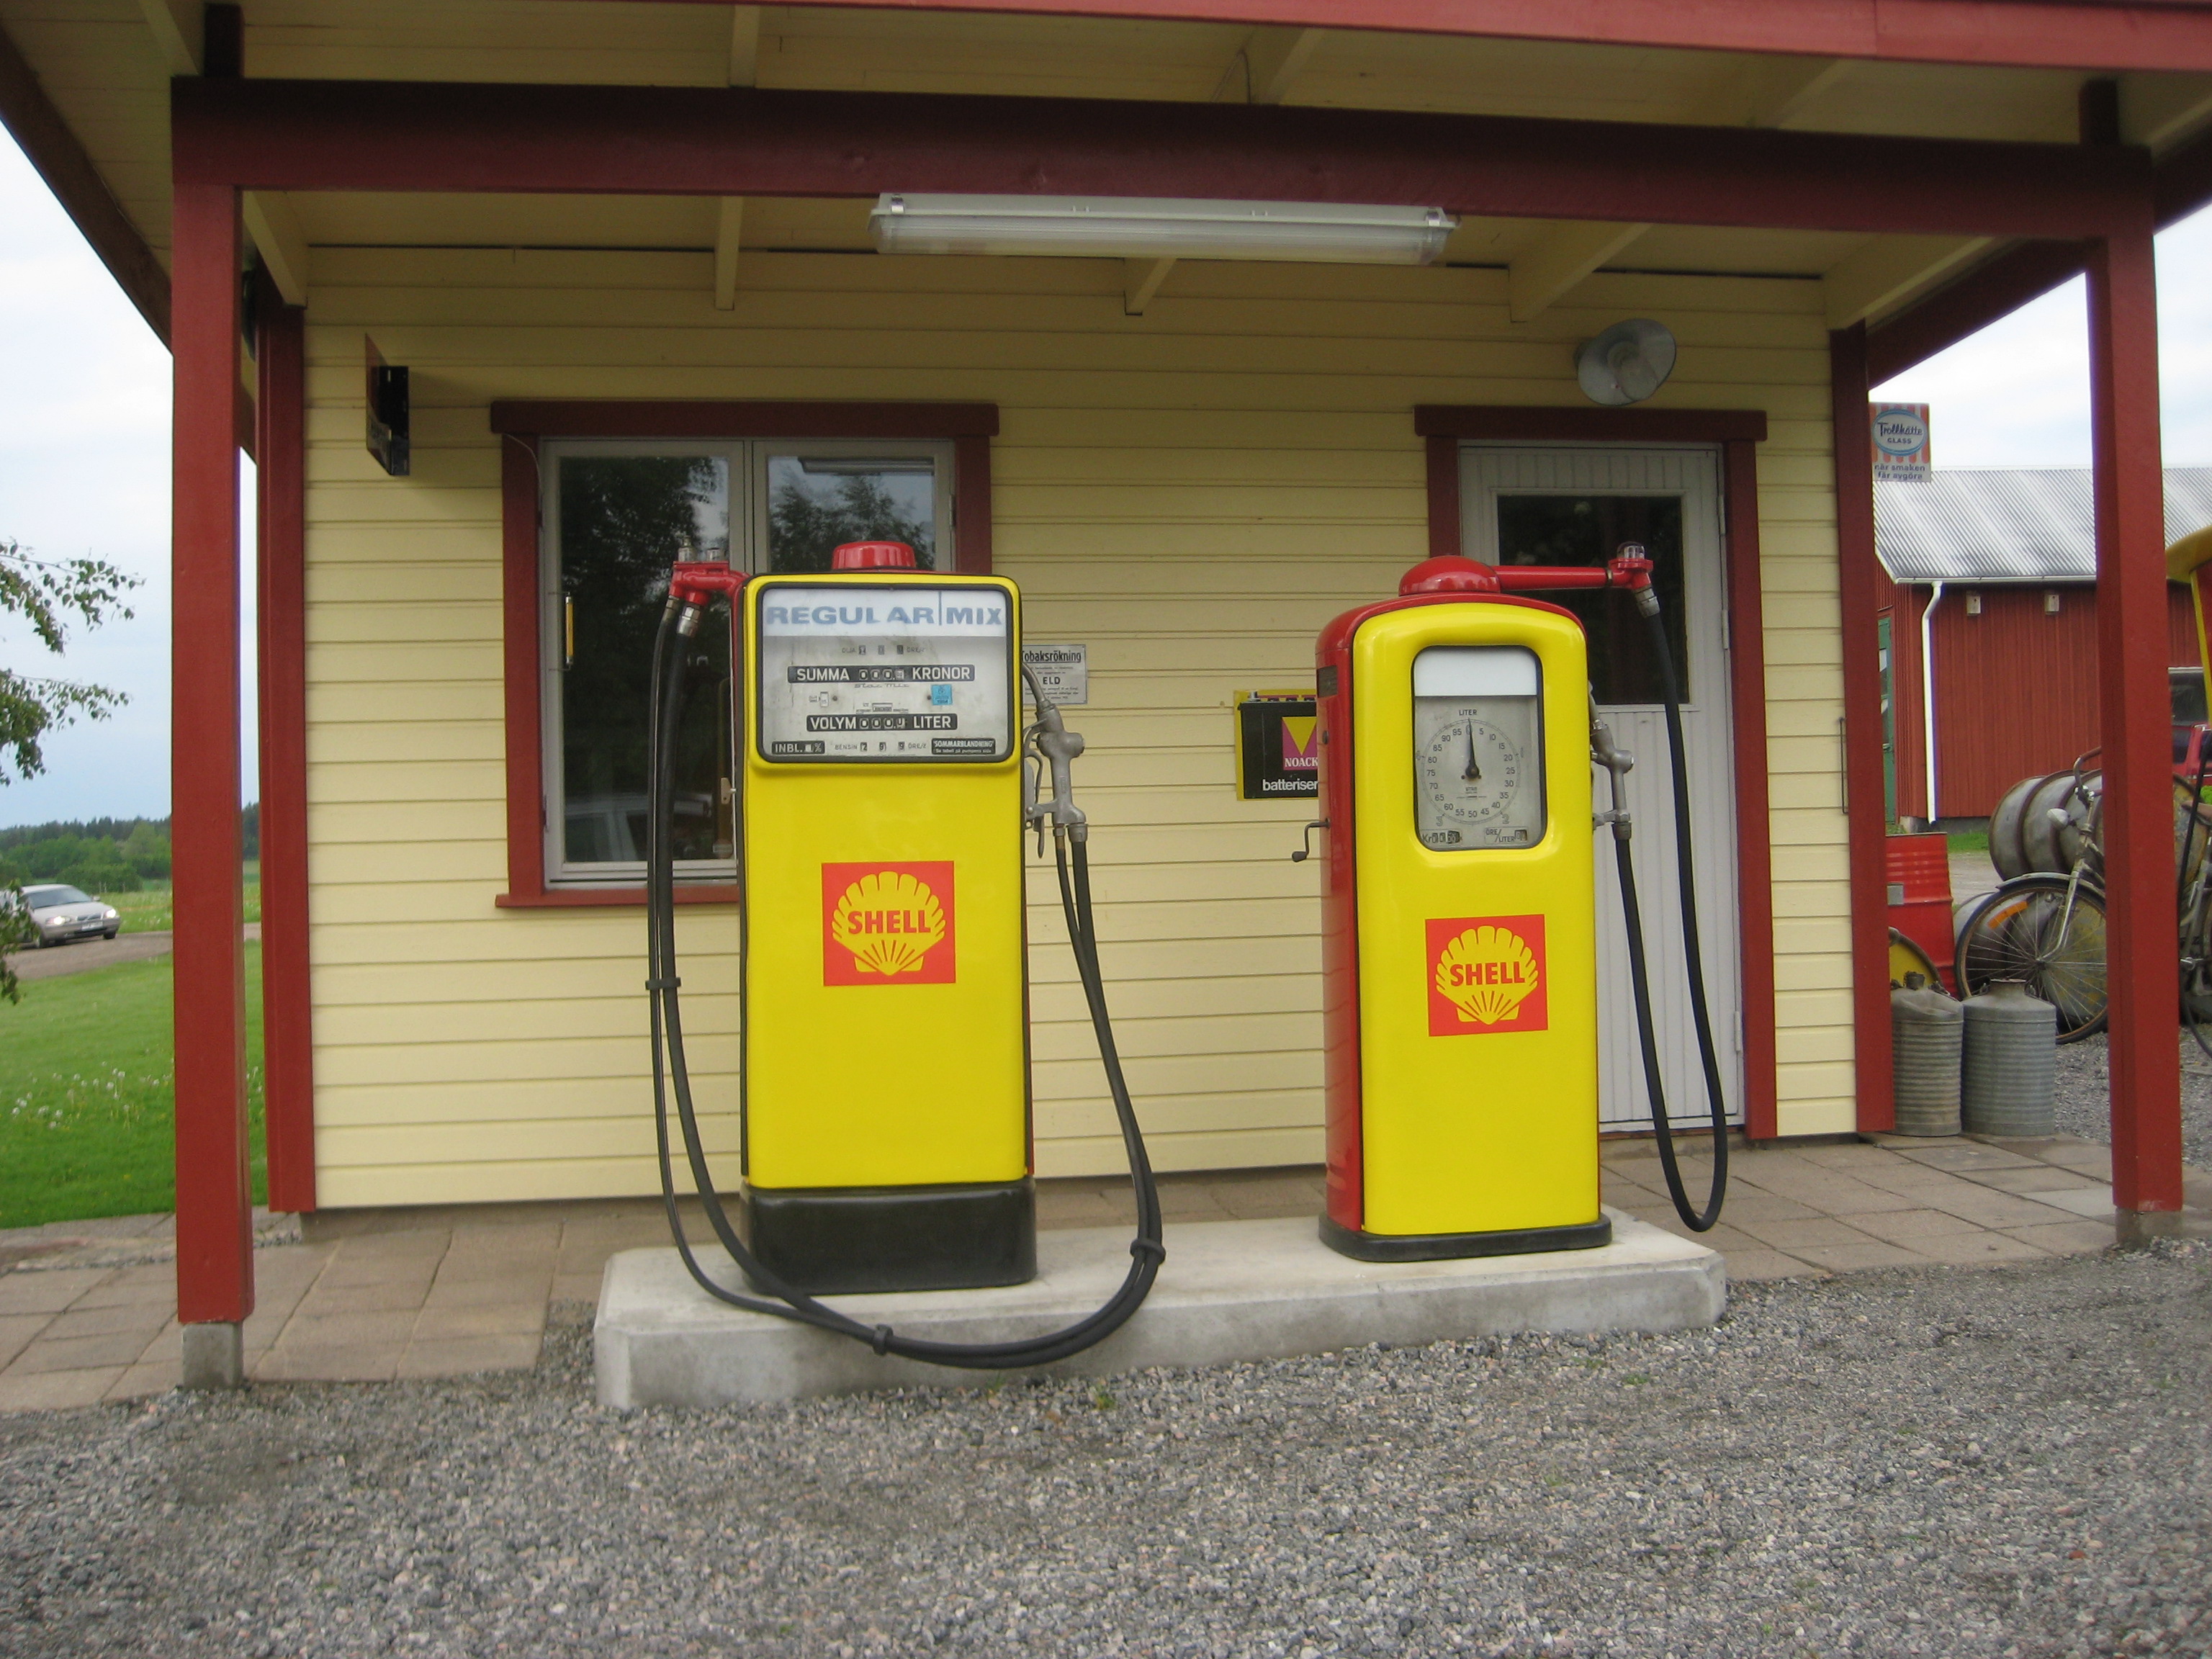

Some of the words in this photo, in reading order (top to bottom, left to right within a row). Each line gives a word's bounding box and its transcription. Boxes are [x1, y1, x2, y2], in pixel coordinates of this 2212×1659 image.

[1892, 463, 1925, 472] smaken
[766, 606, 935, 625] REGULAR
[946, 606, 1002, 626] MIX
[796, 667, 850, 681] SUMMA
[912, 666, 971, 680] KRONOR
[1043, 676, 1061, 685] ELD
[810, 716, 857, 730] VOLYM
[912, 715, 952, 729] LITER
[775, 743, 803, 753] INBL.
[1284, 757, 1318, 768] NOACK
[1262, 778, 1318, 791] batteriser
[848, 909, 931, 935] SHELL
[1449, 961, 1526, 987] SHELL
